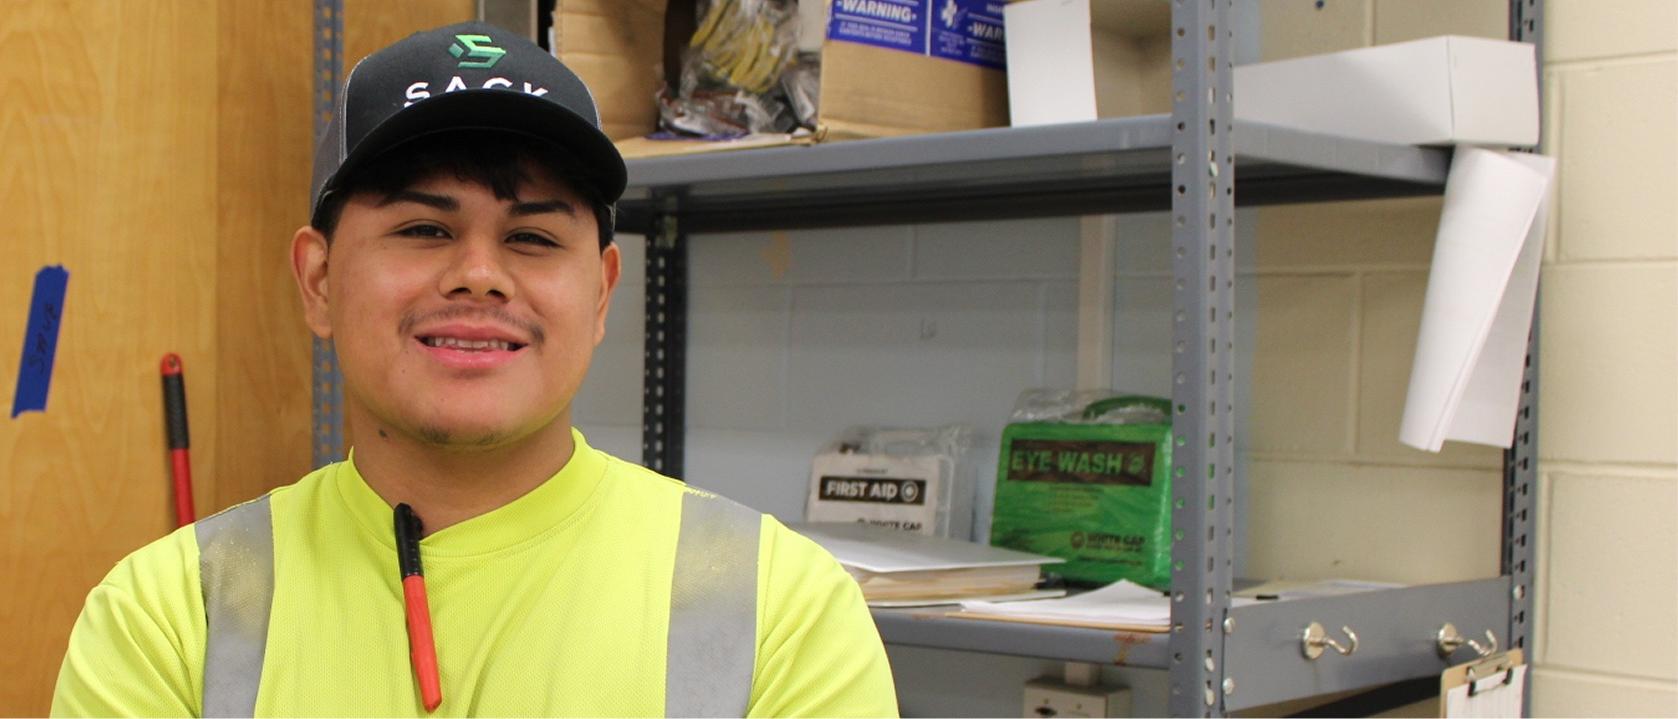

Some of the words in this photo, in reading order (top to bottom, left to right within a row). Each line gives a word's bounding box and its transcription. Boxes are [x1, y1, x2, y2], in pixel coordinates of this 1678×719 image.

[842, 0, 912, 22] WARNING
[1010, 449, 1051, 472] EYE
[1057, 451, 1123, 475] WASH
[825, 480, 867, 498] FIRST
[869, 481, 899, 500] AID
